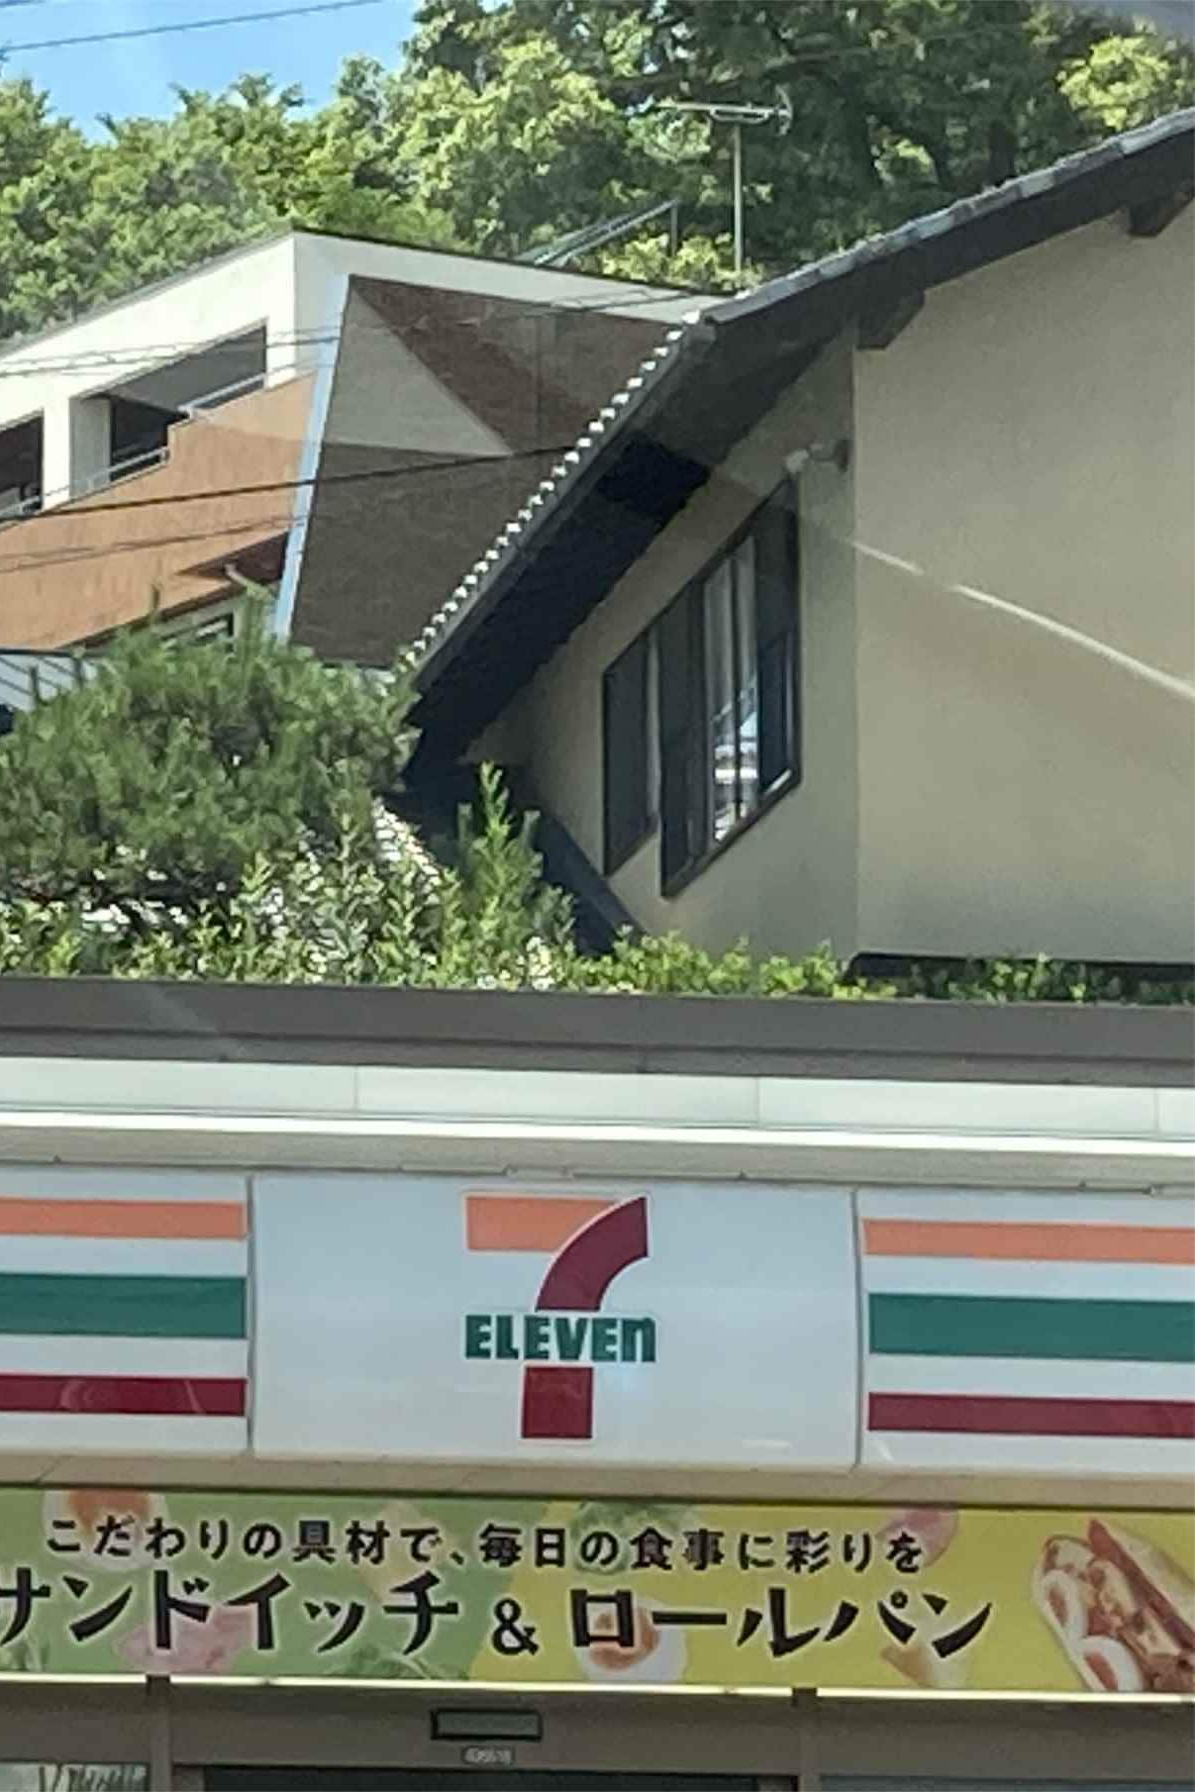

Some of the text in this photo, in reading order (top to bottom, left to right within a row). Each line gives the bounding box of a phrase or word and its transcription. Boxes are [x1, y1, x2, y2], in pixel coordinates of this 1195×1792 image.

[46, 1518, 924, 1573] こだわりの具材で、毎日の食事に彩りを
[491, 1598, 540, 1656] &
[570, 1587, 993, 1660] ロールパン
